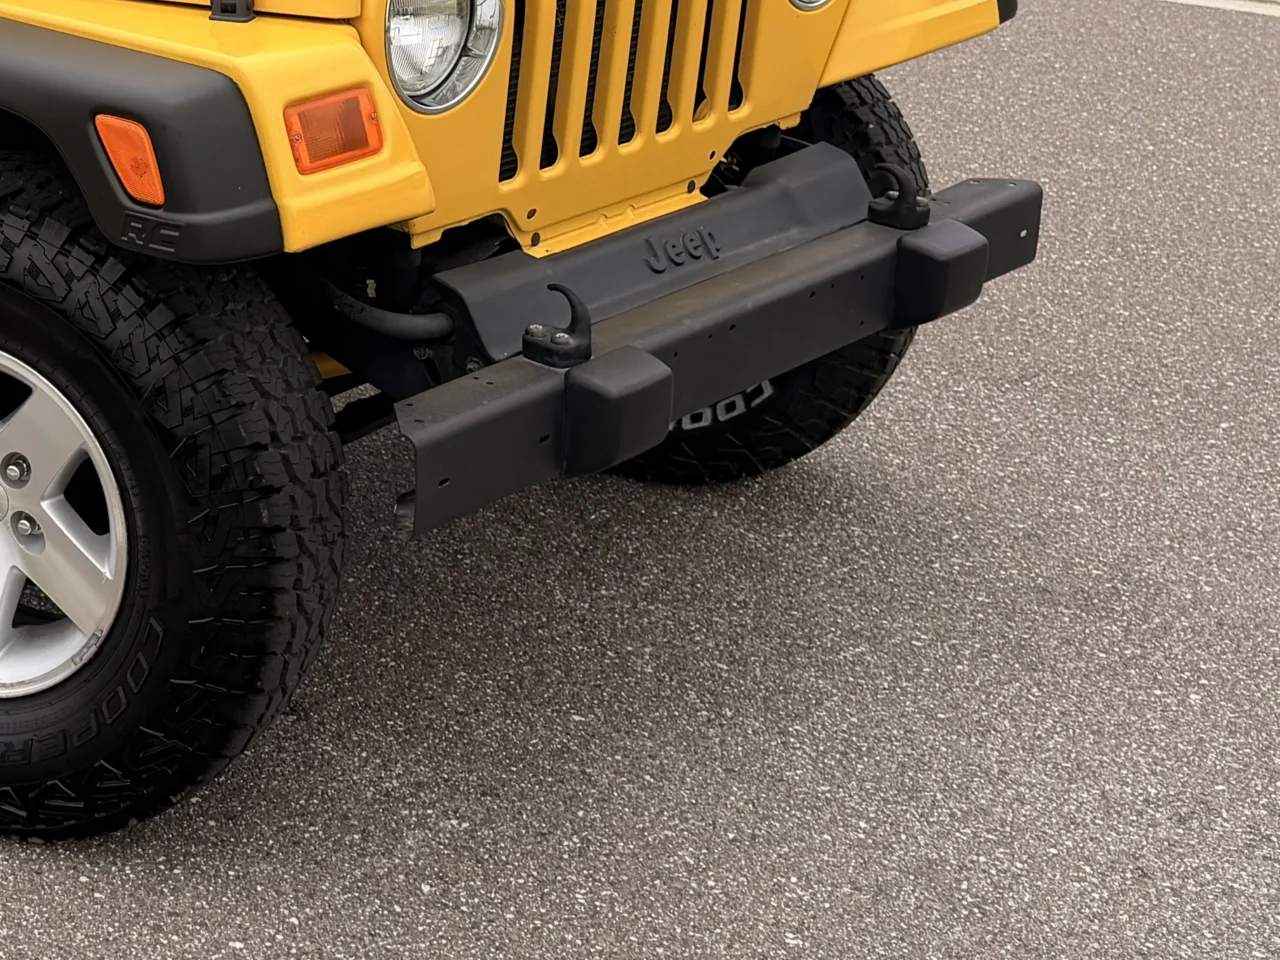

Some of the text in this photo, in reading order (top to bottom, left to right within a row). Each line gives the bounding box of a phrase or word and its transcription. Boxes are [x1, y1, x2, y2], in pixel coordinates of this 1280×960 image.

[642, 226, 721, 275] Jeep
[669, 379, 775, 431] COO
[0, 615, 165, 766] COOPER
